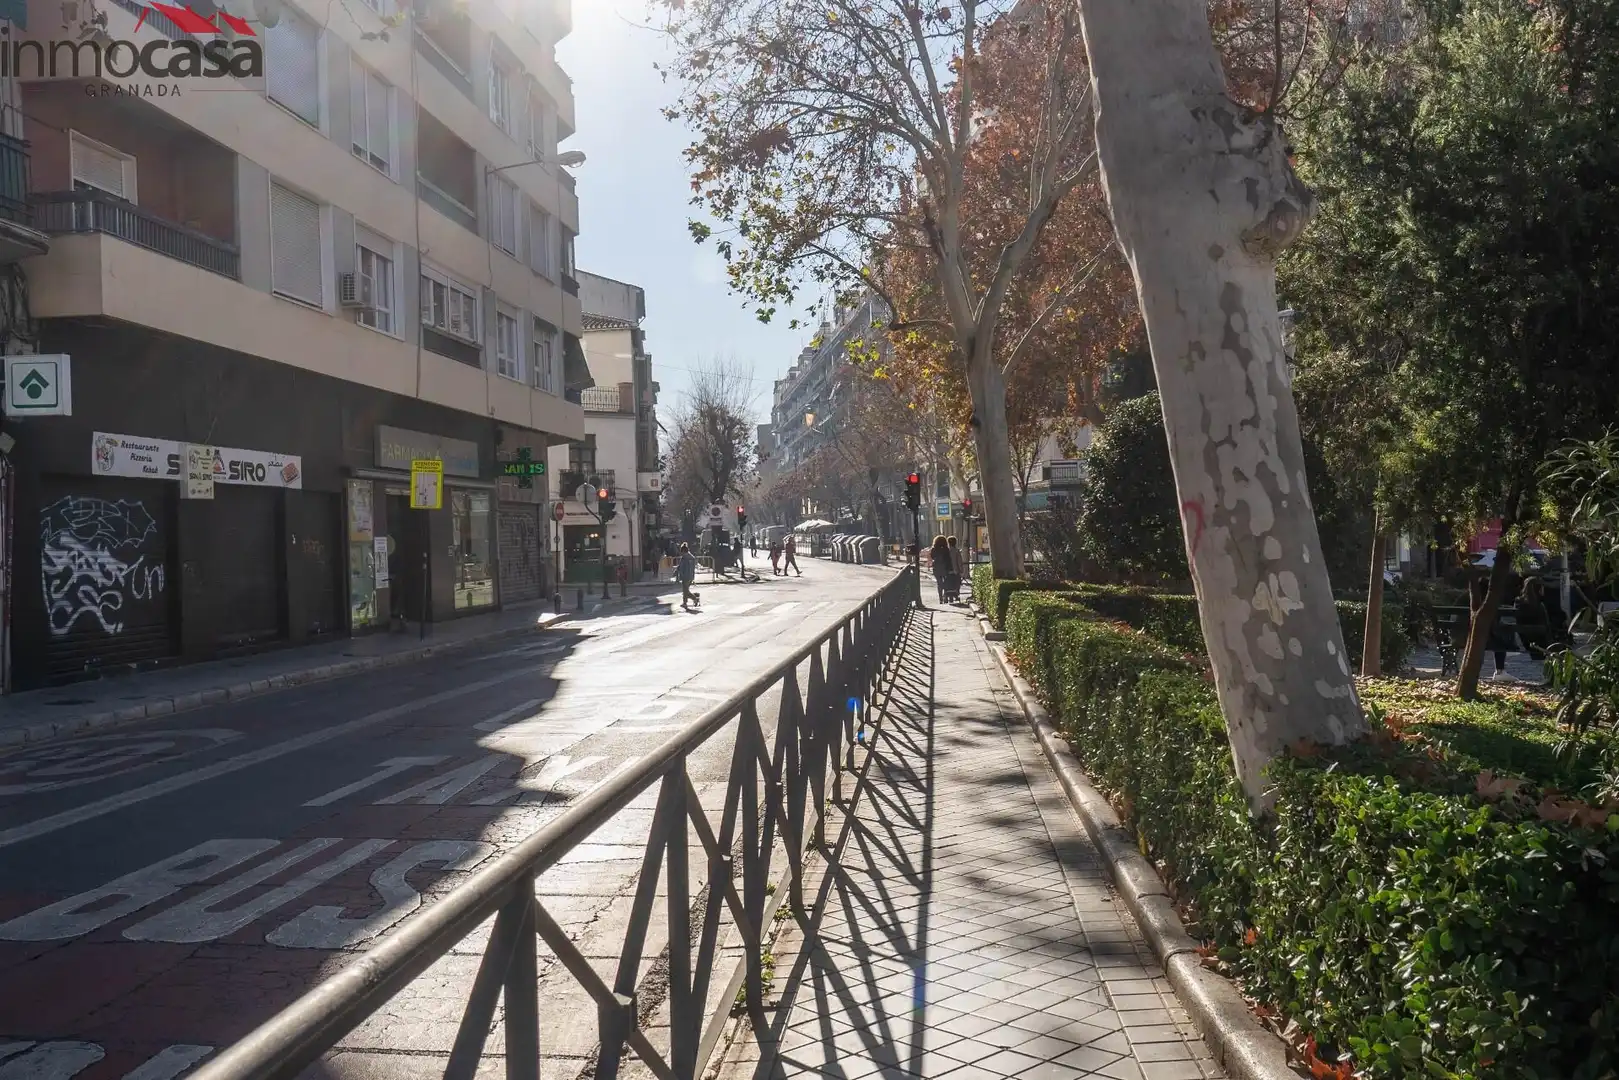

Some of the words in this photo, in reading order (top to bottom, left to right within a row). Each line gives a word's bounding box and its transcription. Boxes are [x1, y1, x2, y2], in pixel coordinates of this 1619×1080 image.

[120, 440, 160, 453] Restaurante
[228, 460, 266, 482] SIRO
[0, 838, 500, 950] BUS
